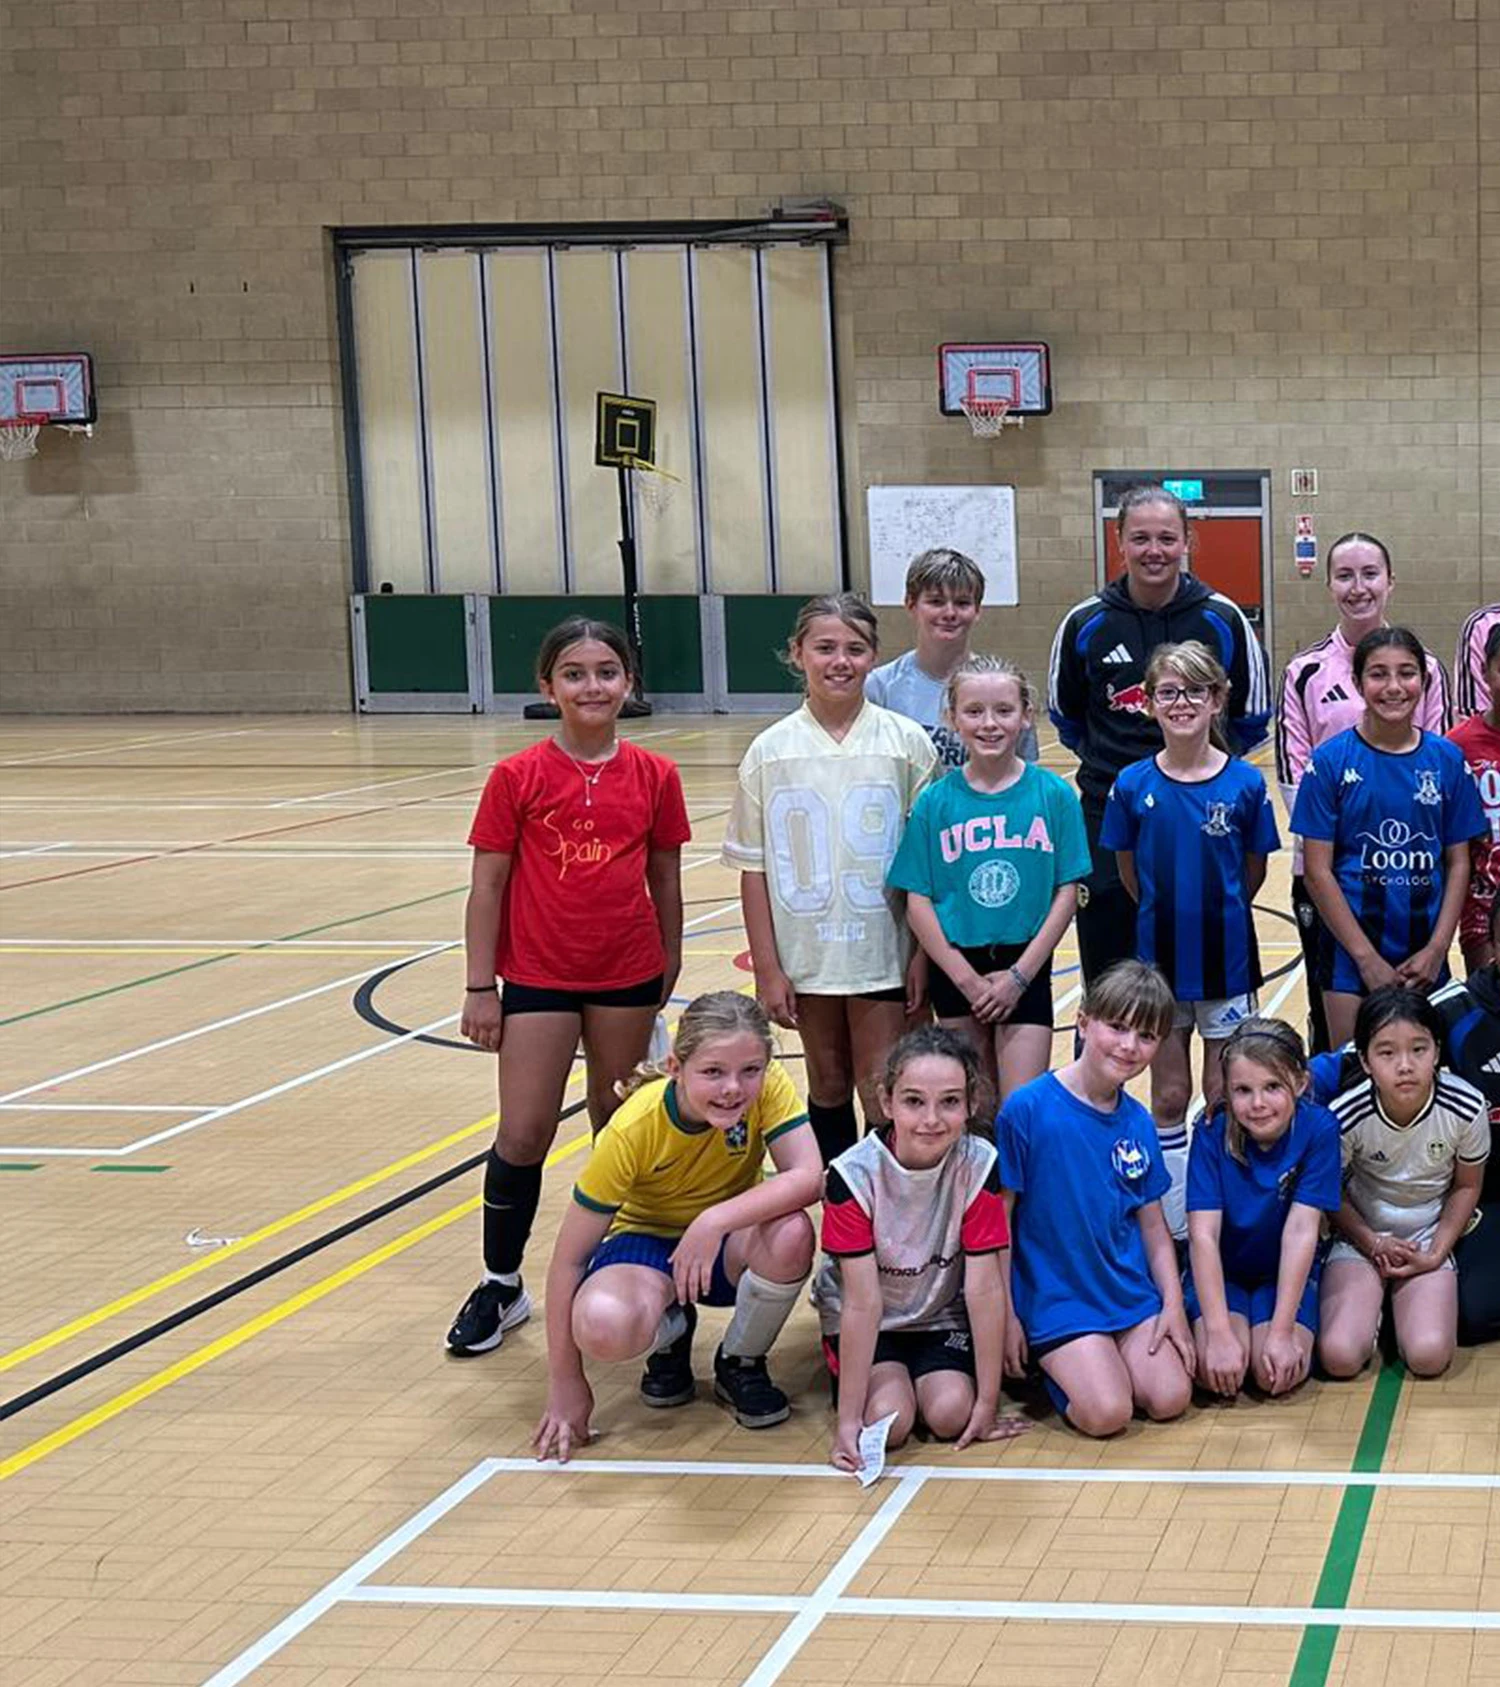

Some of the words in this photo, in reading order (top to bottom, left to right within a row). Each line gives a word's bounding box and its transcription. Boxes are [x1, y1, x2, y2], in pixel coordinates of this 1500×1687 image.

[543, 810, 612, 880] Spain
[767, 781, 901, 917] 09
[940, 815, 1054, 863] UCLA
[1360, 843, 1434, 870] Loom
